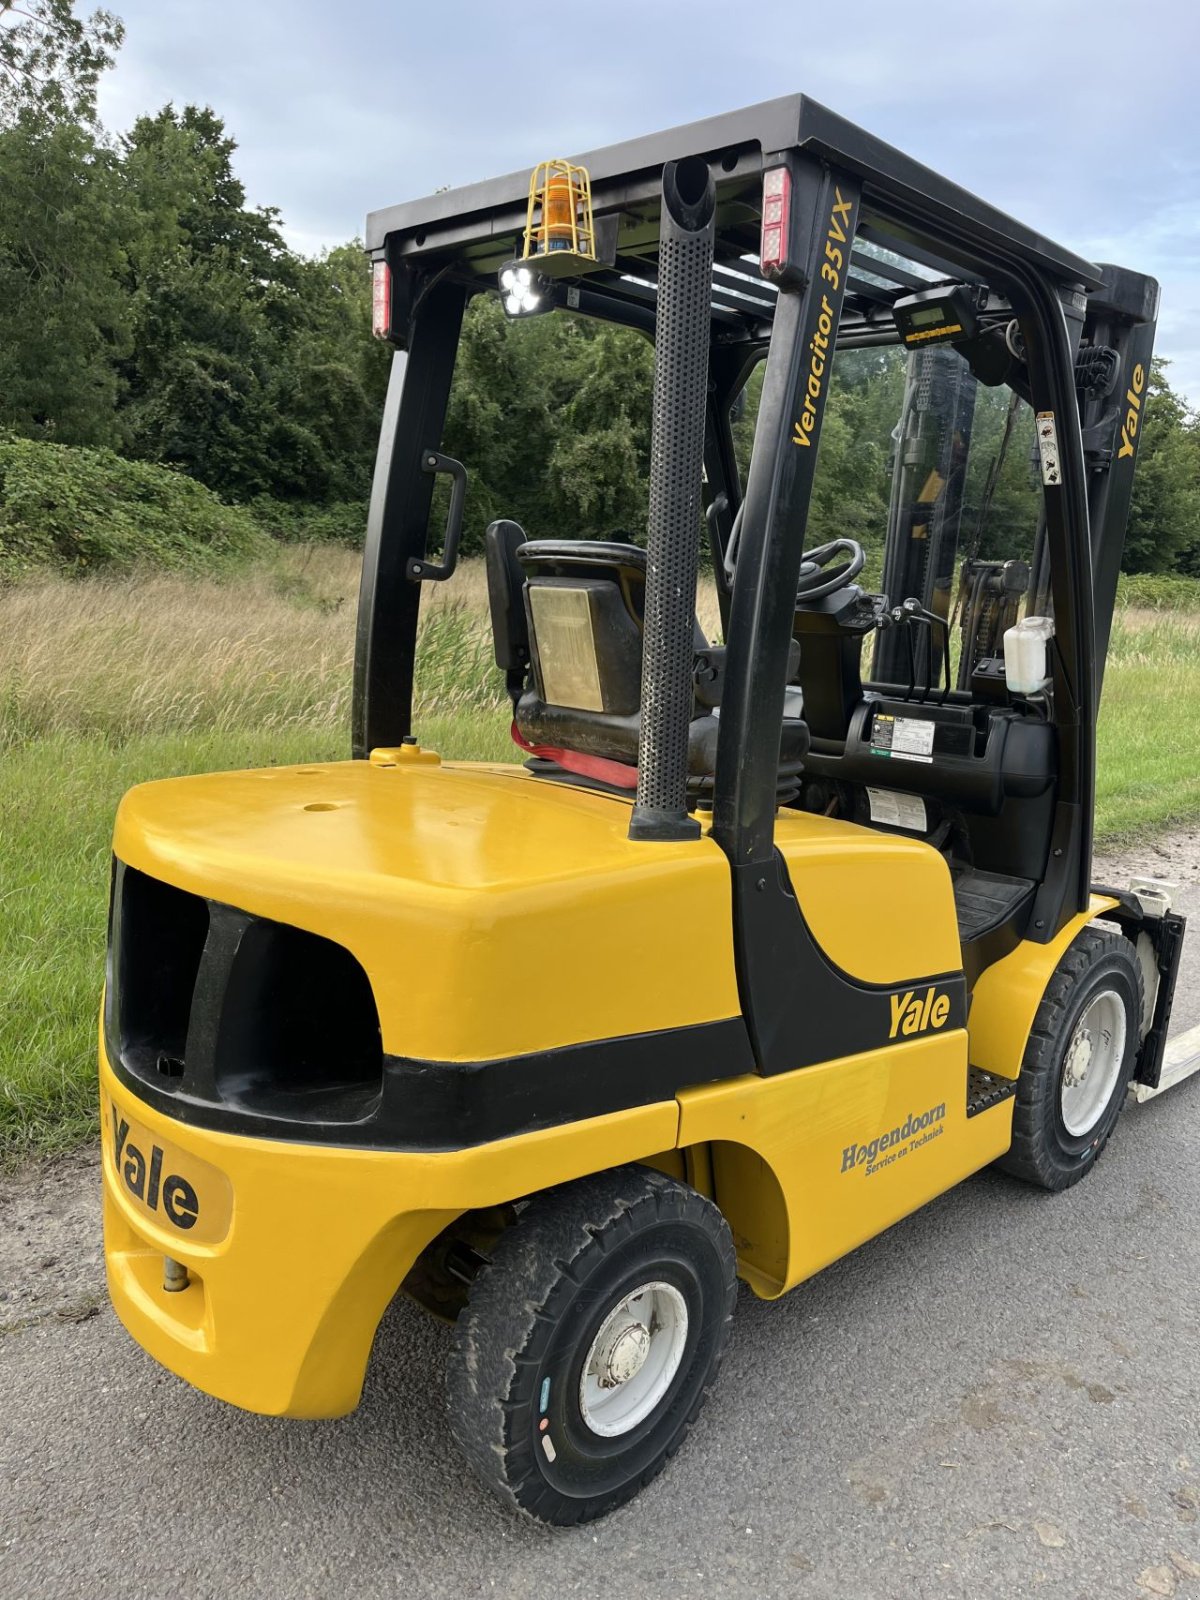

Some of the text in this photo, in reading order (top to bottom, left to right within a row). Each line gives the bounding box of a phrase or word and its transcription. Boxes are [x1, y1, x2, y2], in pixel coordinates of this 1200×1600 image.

[792, 186, 853, 447] Veracitor 35VX
[1118, 363, 1144, 459] Yale
[888, 987, 951, 1039] Yale
[112, 1103, 199, 1230] Yale
[840, 1102, 946, 1174] Hogendoorn
[865, 1124, 944, 1176] Service en Techniek
